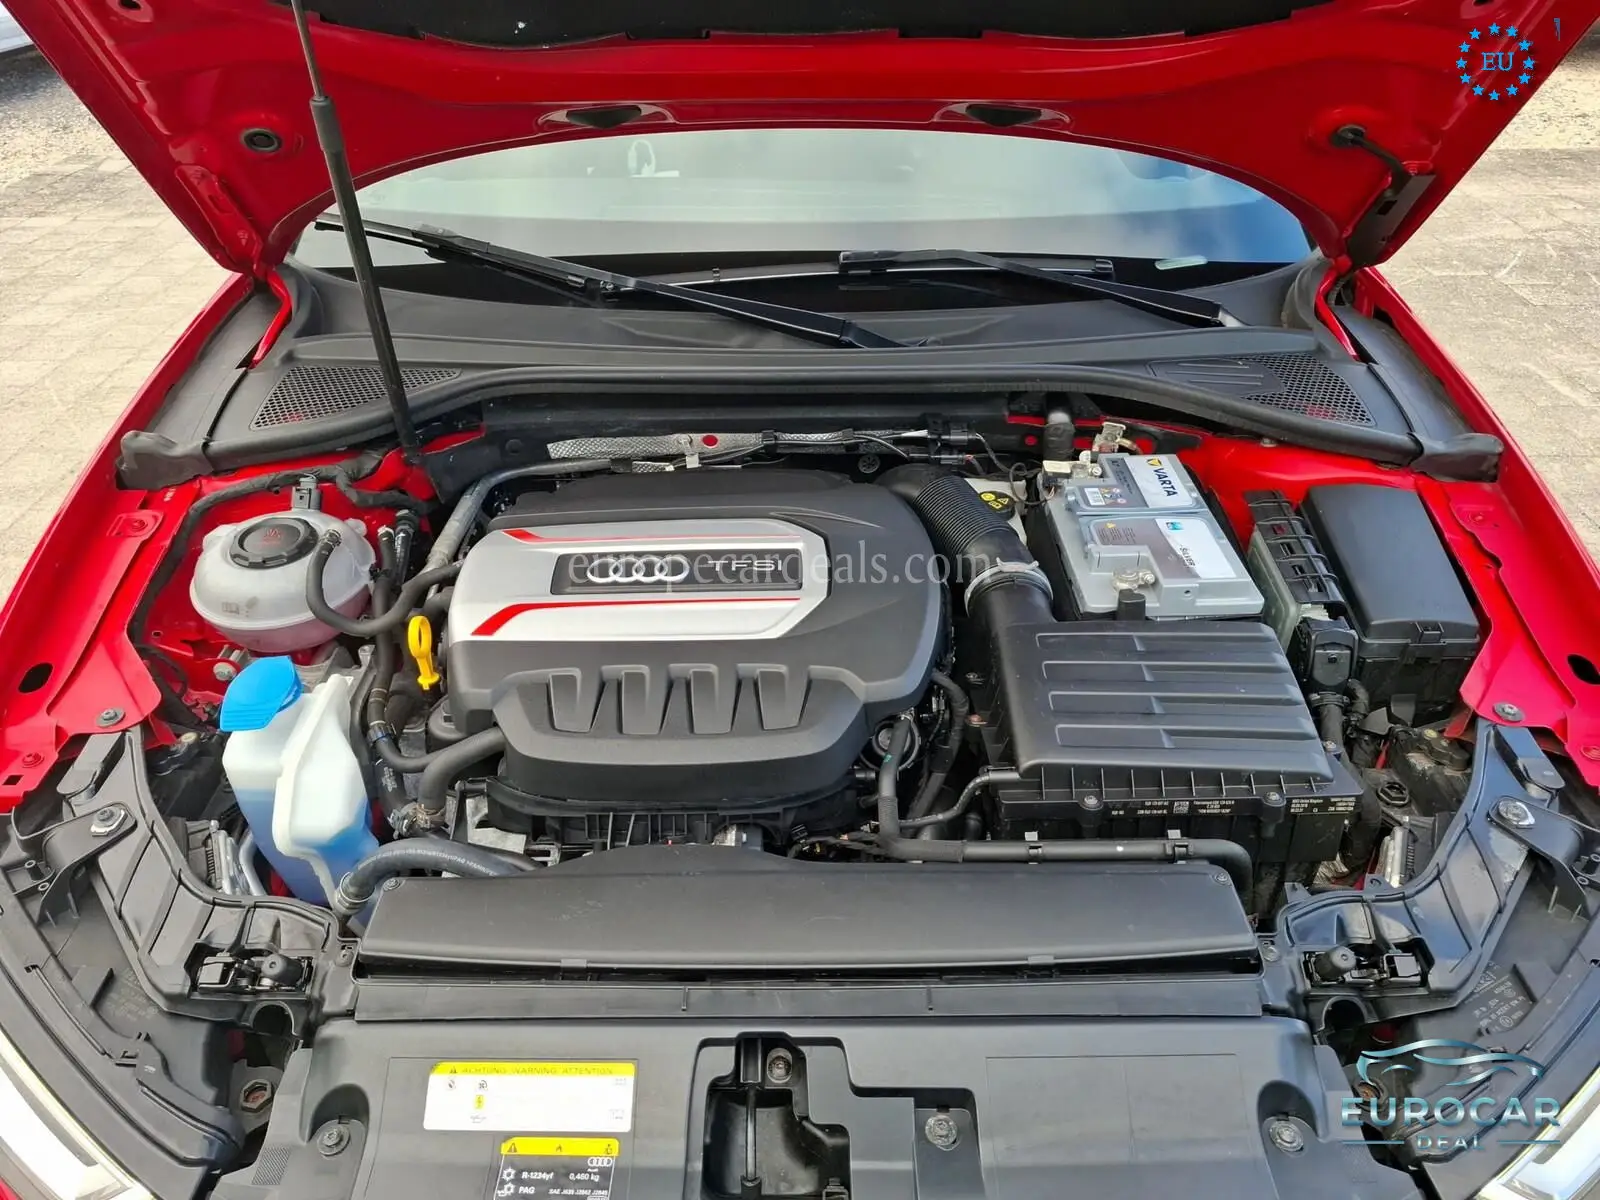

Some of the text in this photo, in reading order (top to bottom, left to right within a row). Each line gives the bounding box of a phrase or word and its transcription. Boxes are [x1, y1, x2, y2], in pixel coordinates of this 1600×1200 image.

[1153, 468, 1178, 497] VARTA
[708, 559, 783, 572] TFSI
[461, 1066, 613, 1075] ACHTUNG WARNING ATTENTION
[521, 1171, 554, 1181] R-1234yf
[518, 1186, 536, 1194] PAG
